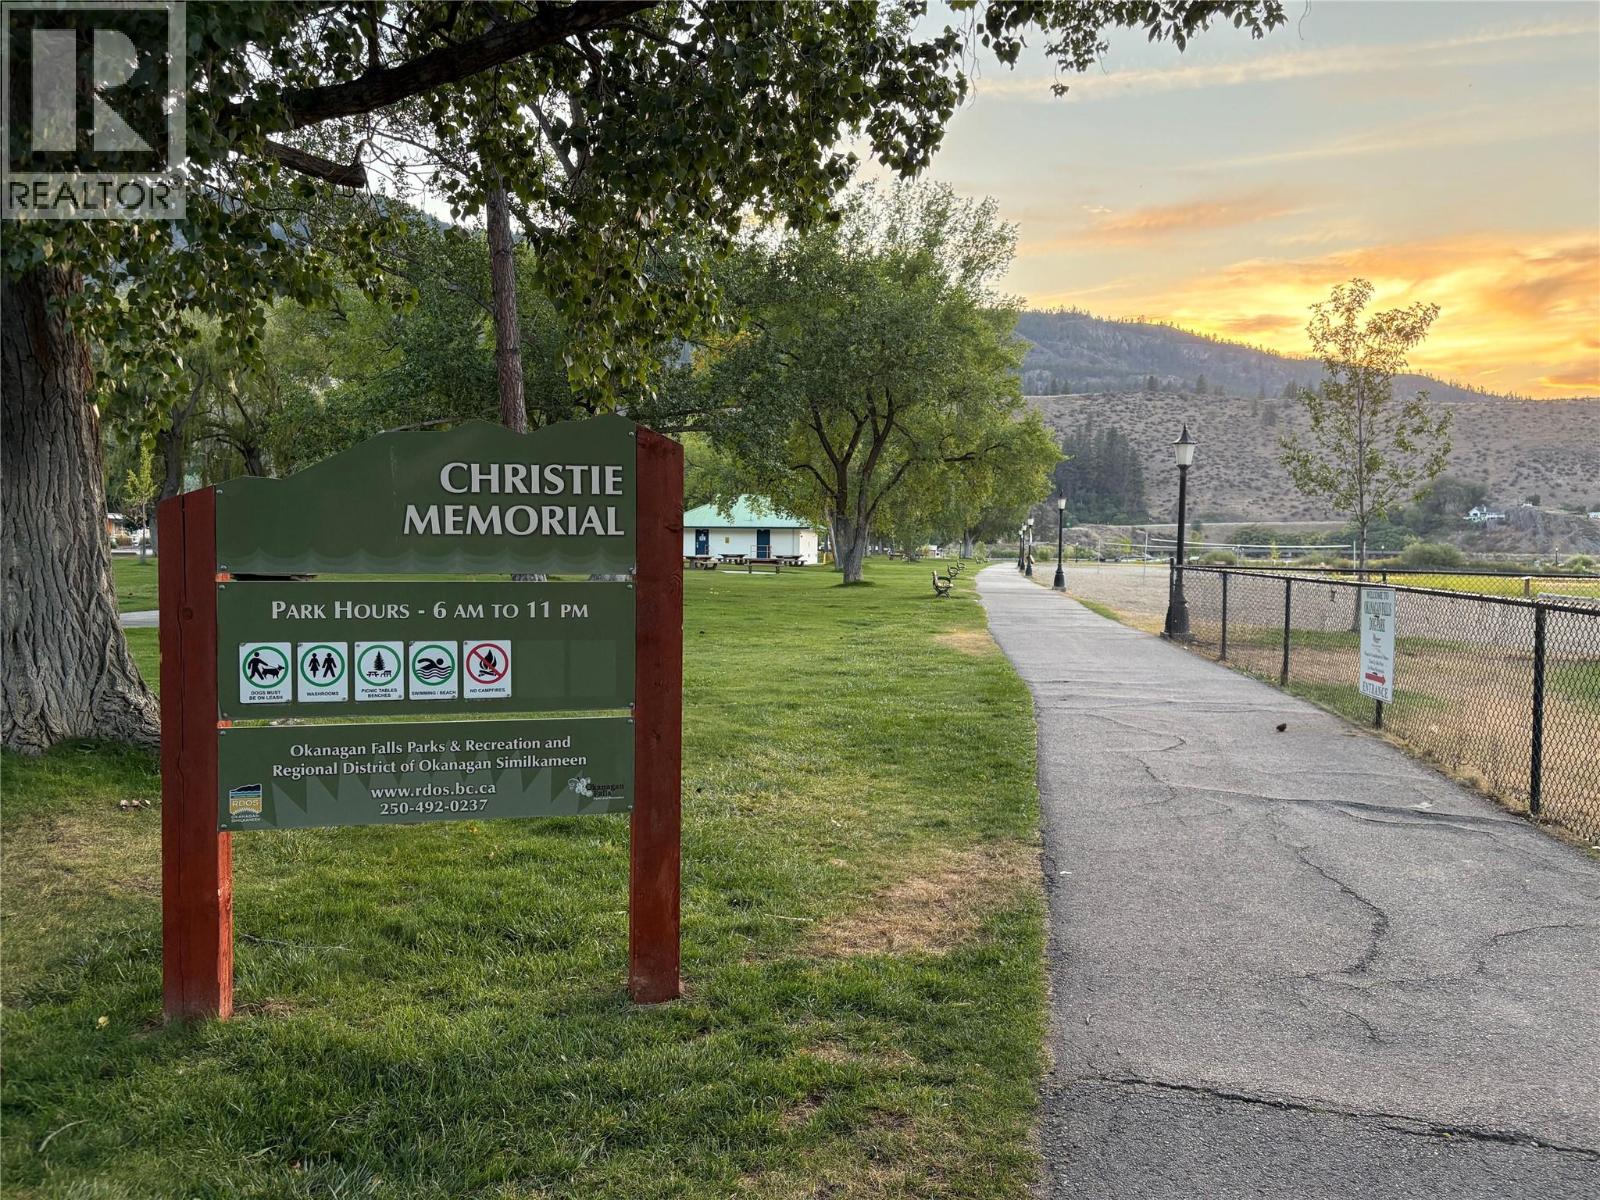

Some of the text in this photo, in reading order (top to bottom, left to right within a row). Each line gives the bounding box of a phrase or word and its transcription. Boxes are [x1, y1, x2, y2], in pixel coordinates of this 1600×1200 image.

[440, 462, 623, 495] CHRISTIE
[403, 504, 625, 536] MEMORIAL
[433, 601, 447, 619] 6
[527, 601, 550, 618] 11
[1363, 681, 1388, 699] ENTRANCE
[290, 736, 571, 759] Okanagan Falls Parks & Recreation and
[272, 755, 587, 780] Regional District of Okanagan Similkameen
[371, 782, 496, 798] www.rdos.bc.ca
[380, 799, 488, 815] 250-492-0237
